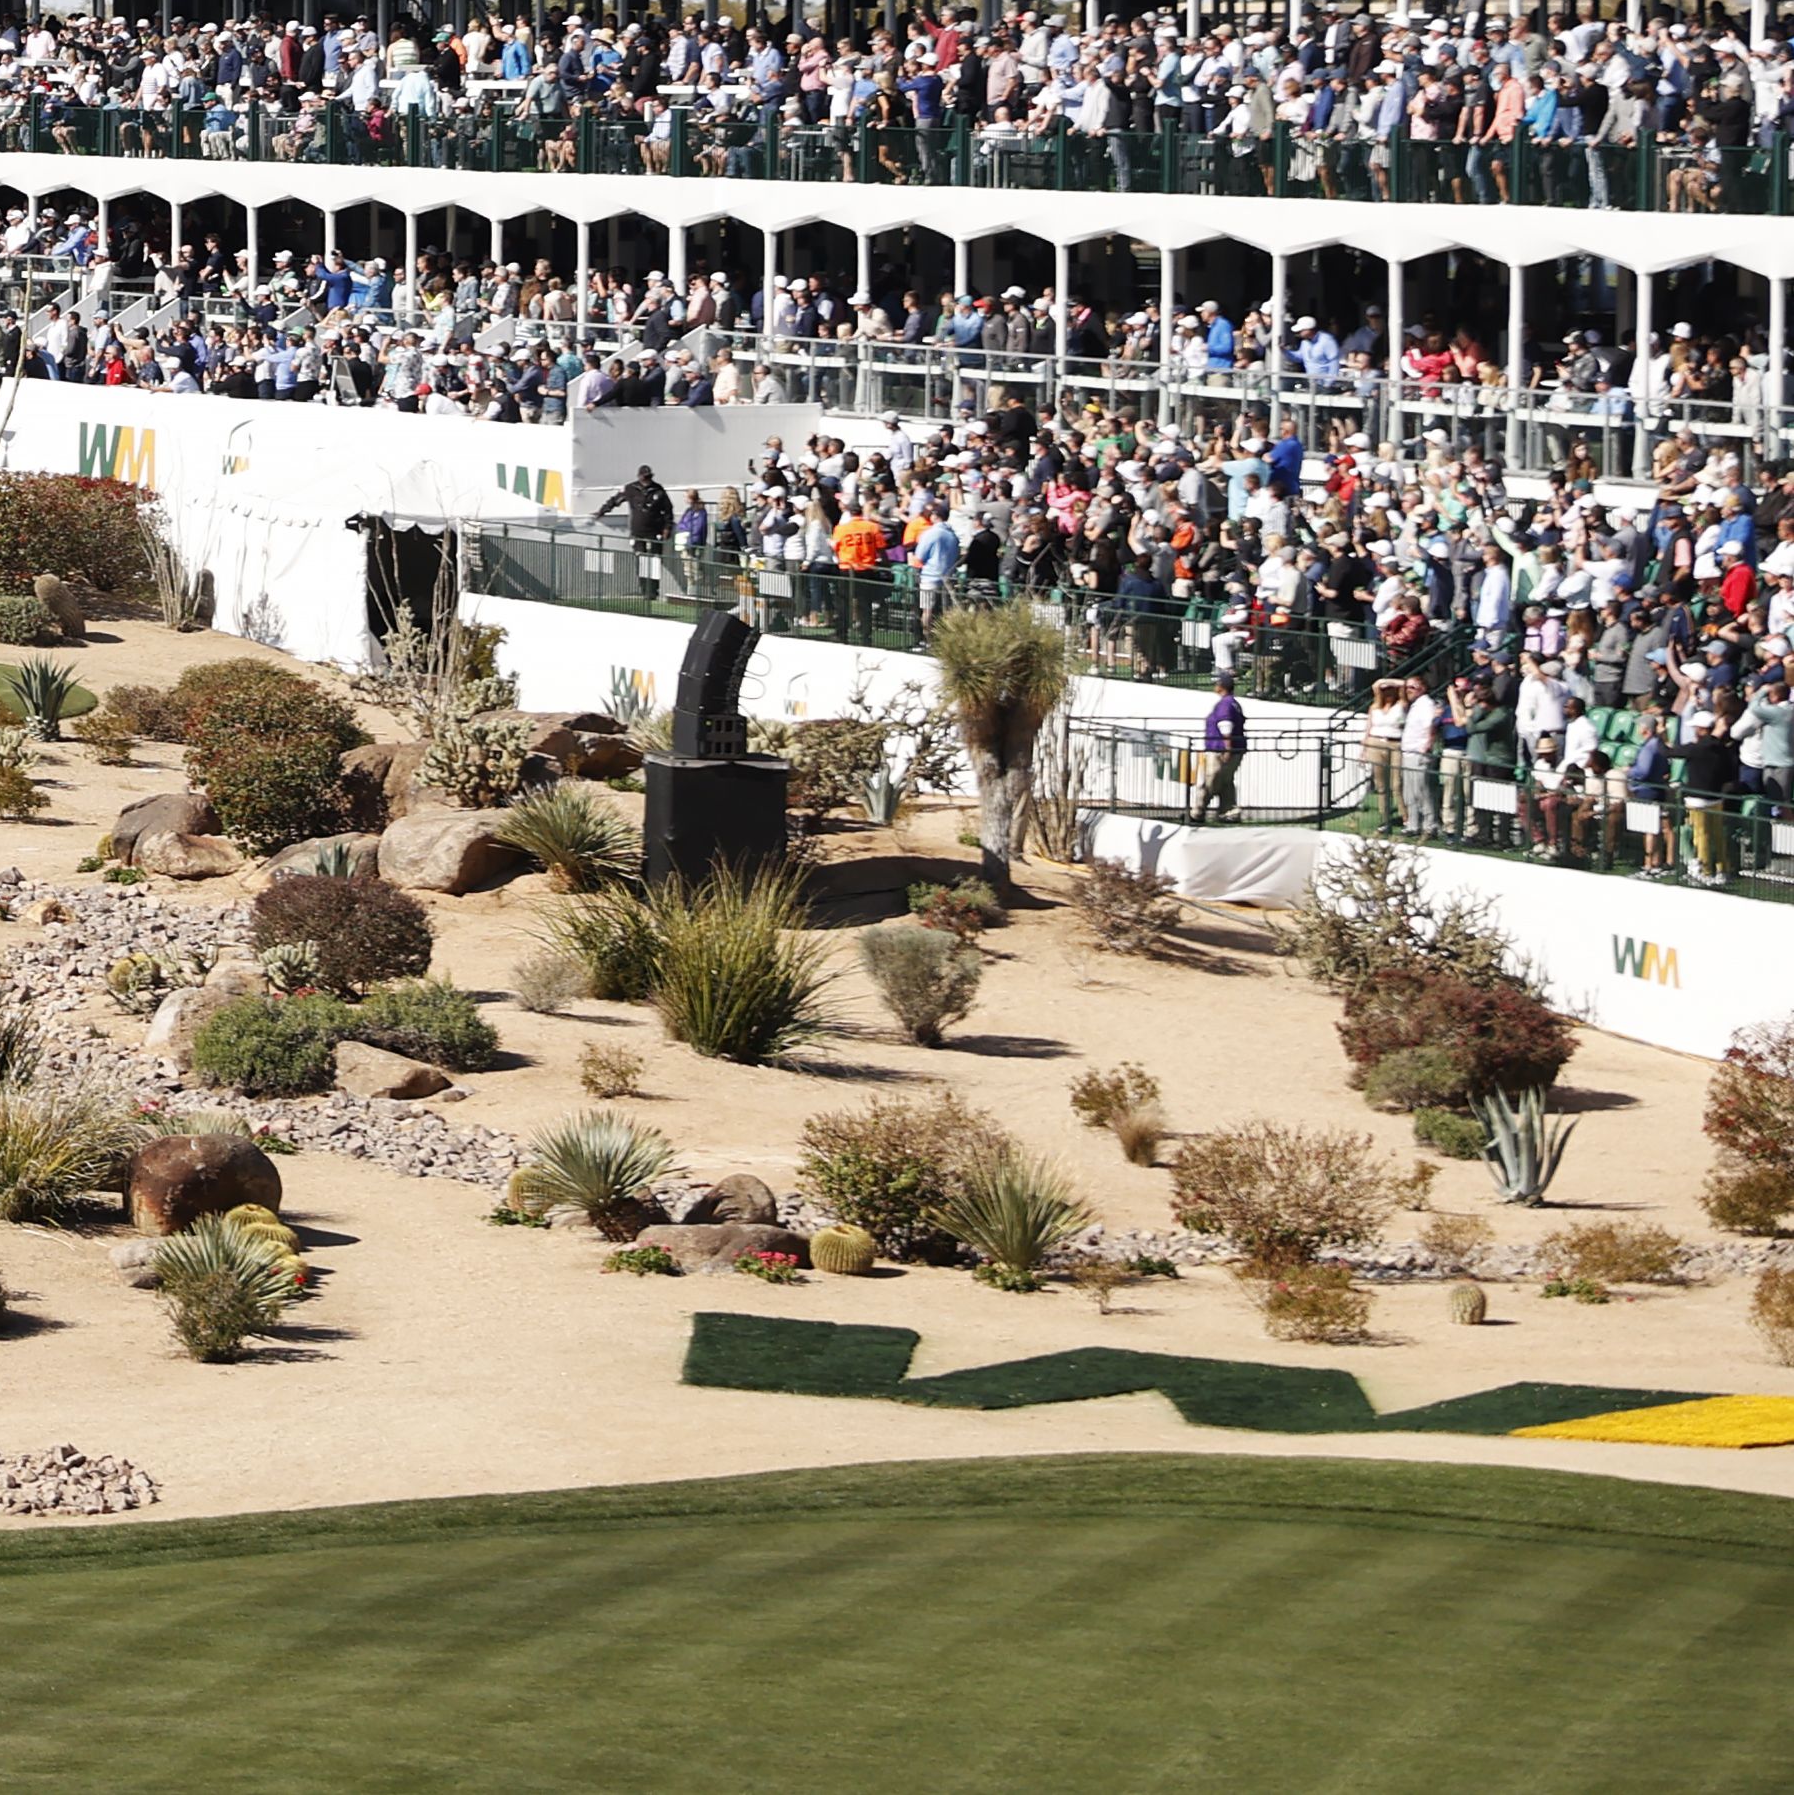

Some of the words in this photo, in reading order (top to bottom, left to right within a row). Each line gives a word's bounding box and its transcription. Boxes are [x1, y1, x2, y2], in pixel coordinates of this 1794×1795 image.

[80, 422, 156, 491] WM
[222, 455, 250, 475] WM
[611, 665, 656, 703] WM
[1612, 934, 1682, 989] WM
